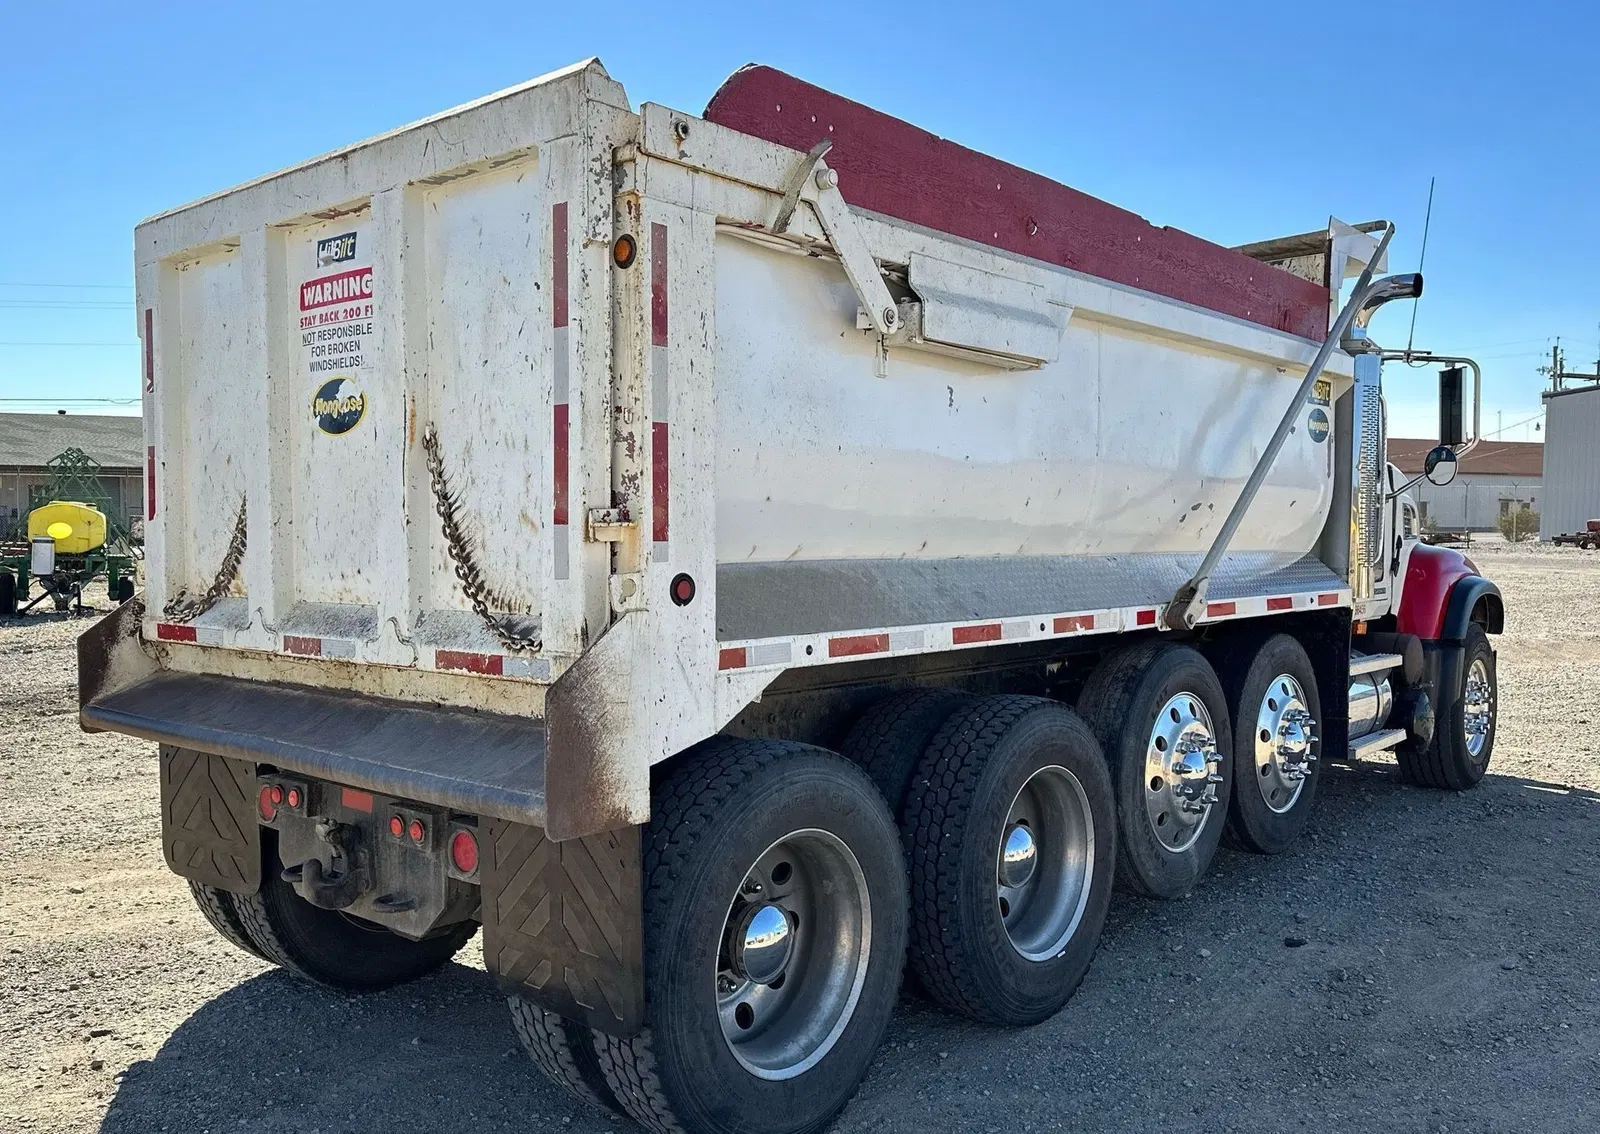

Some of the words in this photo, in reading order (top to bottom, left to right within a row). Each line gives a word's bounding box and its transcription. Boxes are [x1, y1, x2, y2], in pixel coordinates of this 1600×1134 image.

[303, 274, 373, 307] WARNING
[300, 315, 317, 328] STAY
[320, 310, 340, 324] BACK
[343, 306, 361, 320] 200
[302, 331, 316, 344] NOT
[318, 323, 373, 341] RESPONSIBLE
[311, 345, 326, 358] FOR
[328, 339, 360, 355] BROKEN
[309, 355, 363, 373] WINDSHIELDS!
[315, 397, 363, 419] Mongoose
